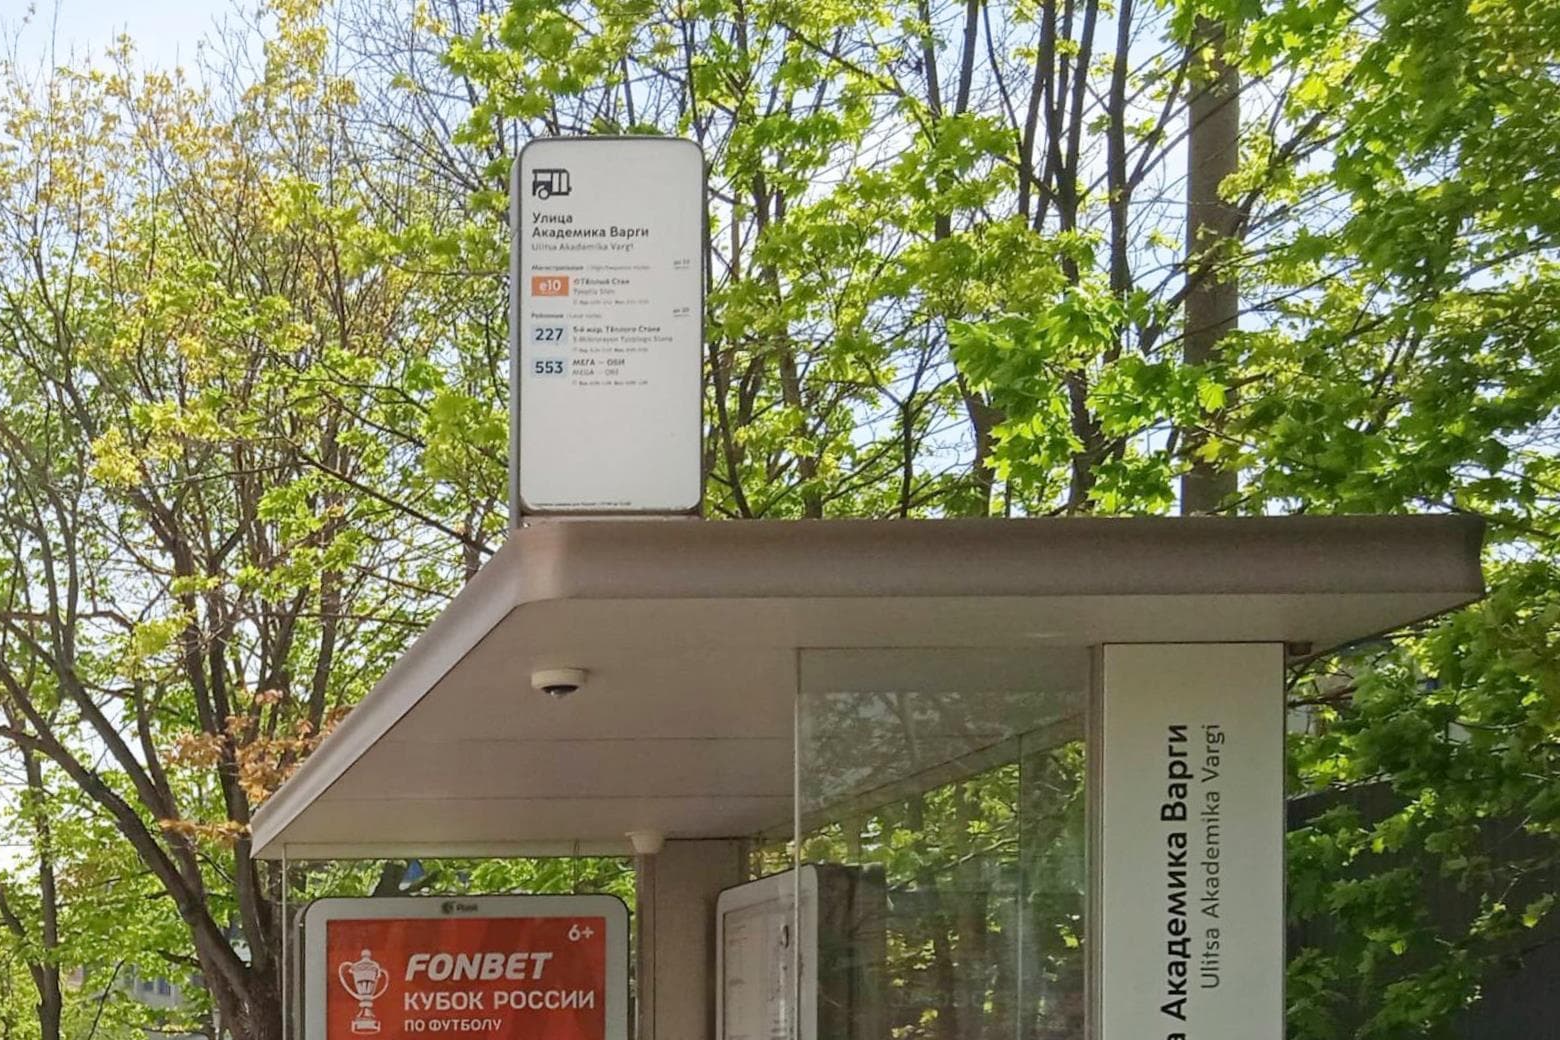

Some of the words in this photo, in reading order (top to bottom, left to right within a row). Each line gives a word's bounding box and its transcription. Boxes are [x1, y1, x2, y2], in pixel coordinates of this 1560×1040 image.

[532, 212, 573, 224] Улица
[532, 227, 606, 239] Академика
[610, 226, 649, 240] Варги
[535, 328, 563, 341] 227
[535, 361, 563, 374] 553
[1200, 723, 1225, 783] Vargi
[1160, 724, 1194, 822] Варги
[1200, 791, 1220, 918] Akademika
[568, 924, 594, 941] 6+
[1160, 831, 1192, 1021] Академика
[405, 952, 553, 981] FONBET
[1200, 927, 1220, 989] Ulitsa
[404, 991, 484, 1011] КУБОК
[494, 989, 594, 1010] РОССИИ
[404, 1019, 426, 1032] ПО
[428, 1018, 502, 1031] ФУТБОЛУ
